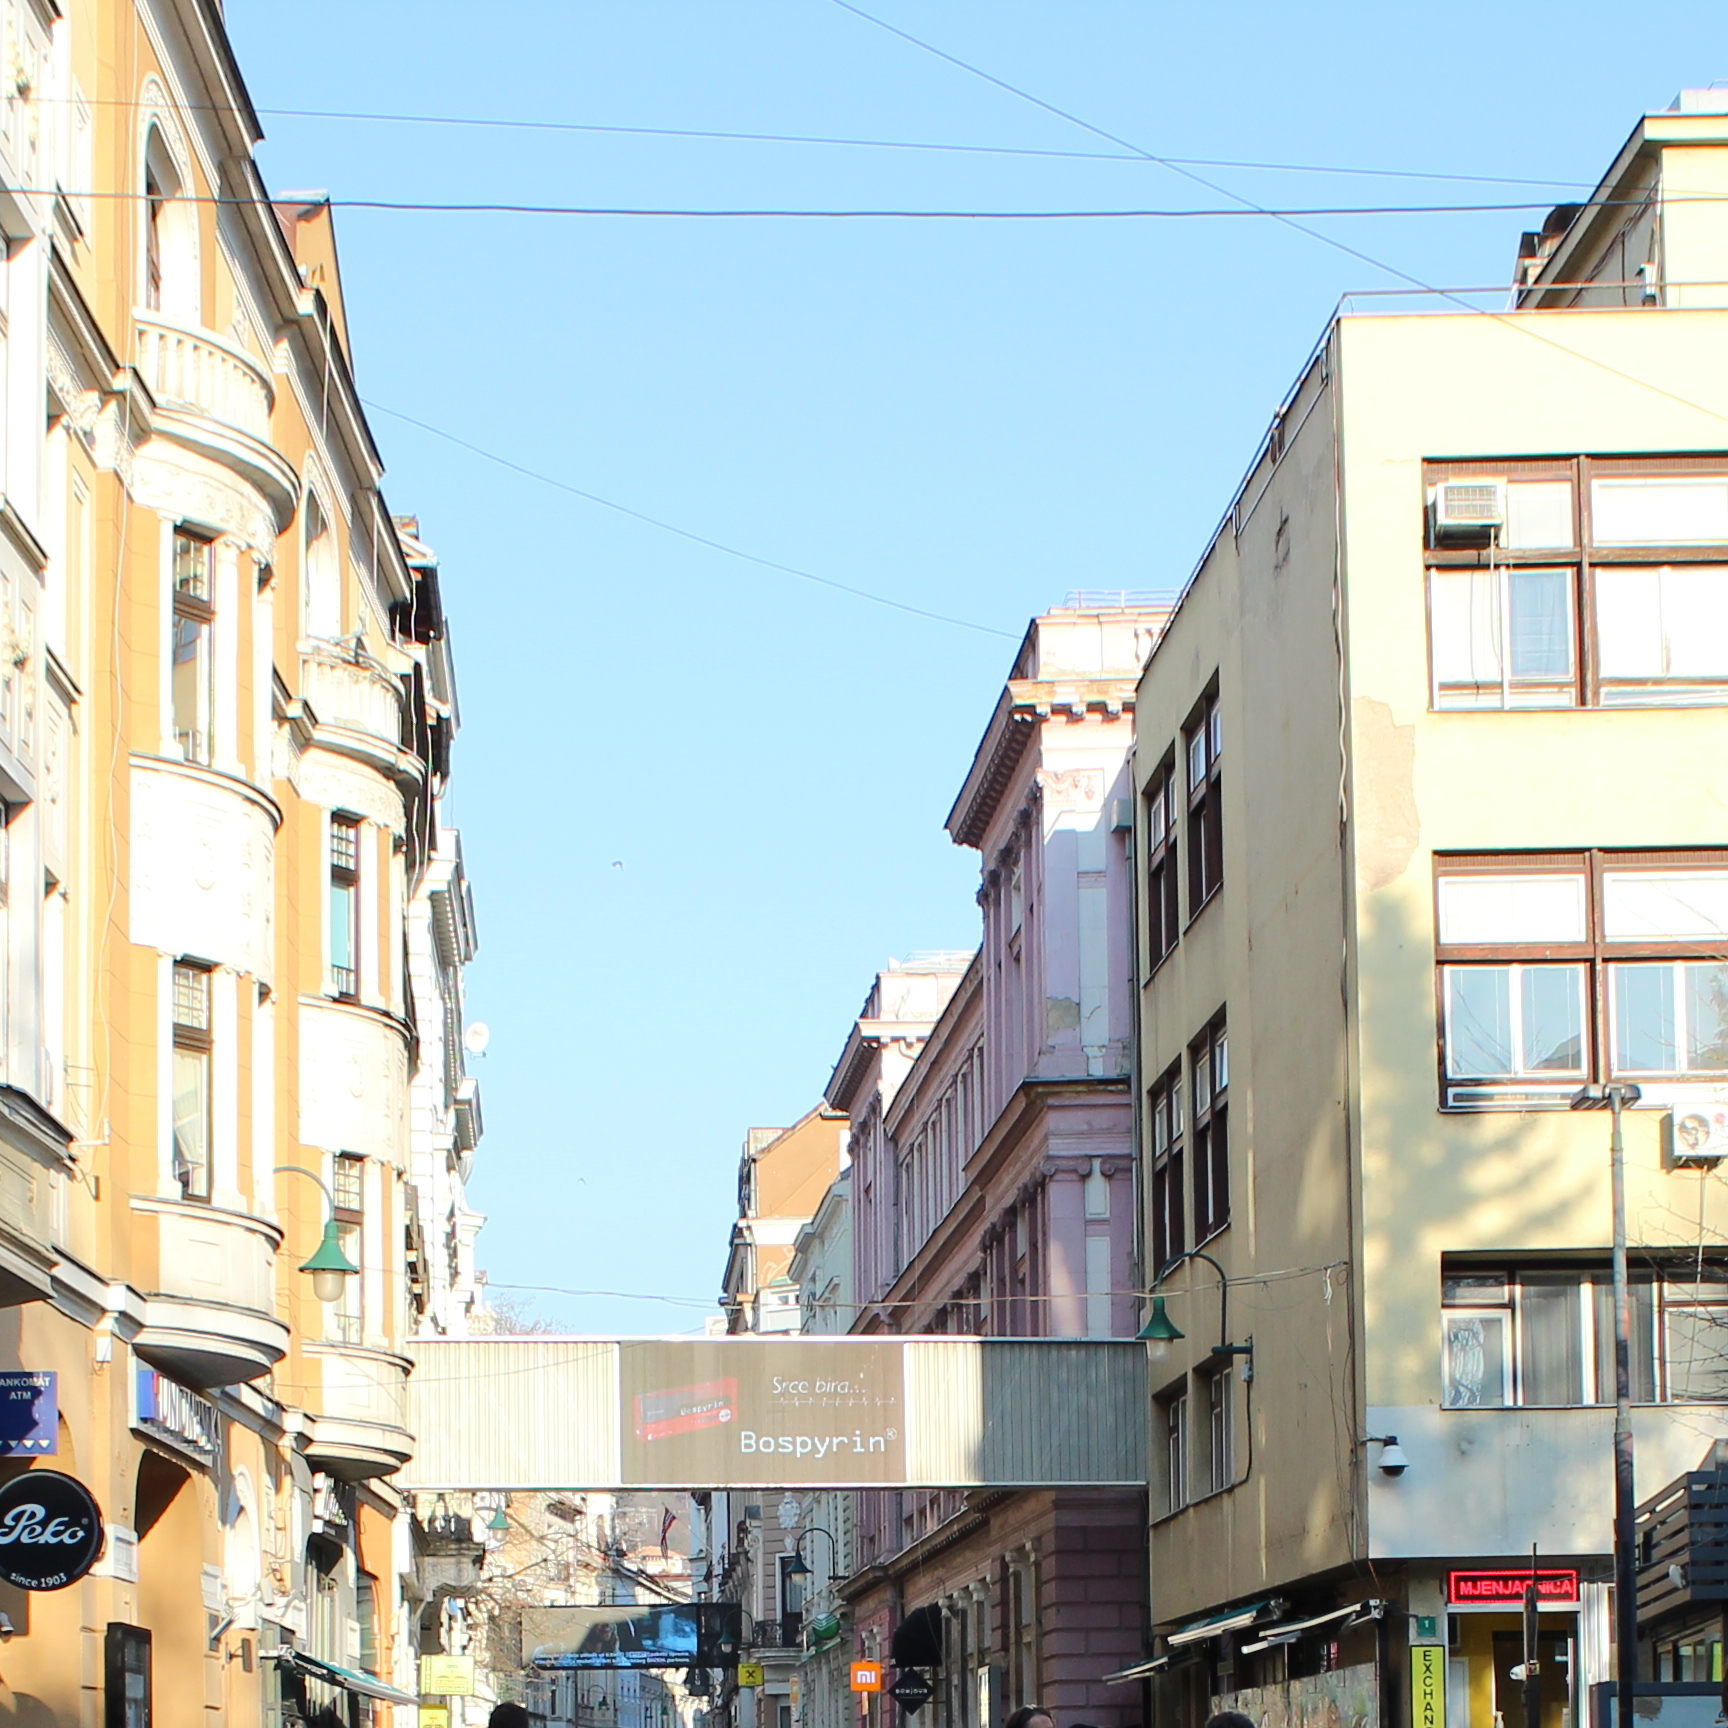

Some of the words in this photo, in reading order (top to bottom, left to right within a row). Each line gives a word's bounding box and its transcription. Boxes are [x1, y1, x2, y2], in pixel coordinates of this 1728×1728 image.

[772, 1376, 810, 1394] Srce
[9, 1390, 32, 1401] ATM
[10, 1571, 39, 1588] since
[40, 1571, 68, 1588] 1903
